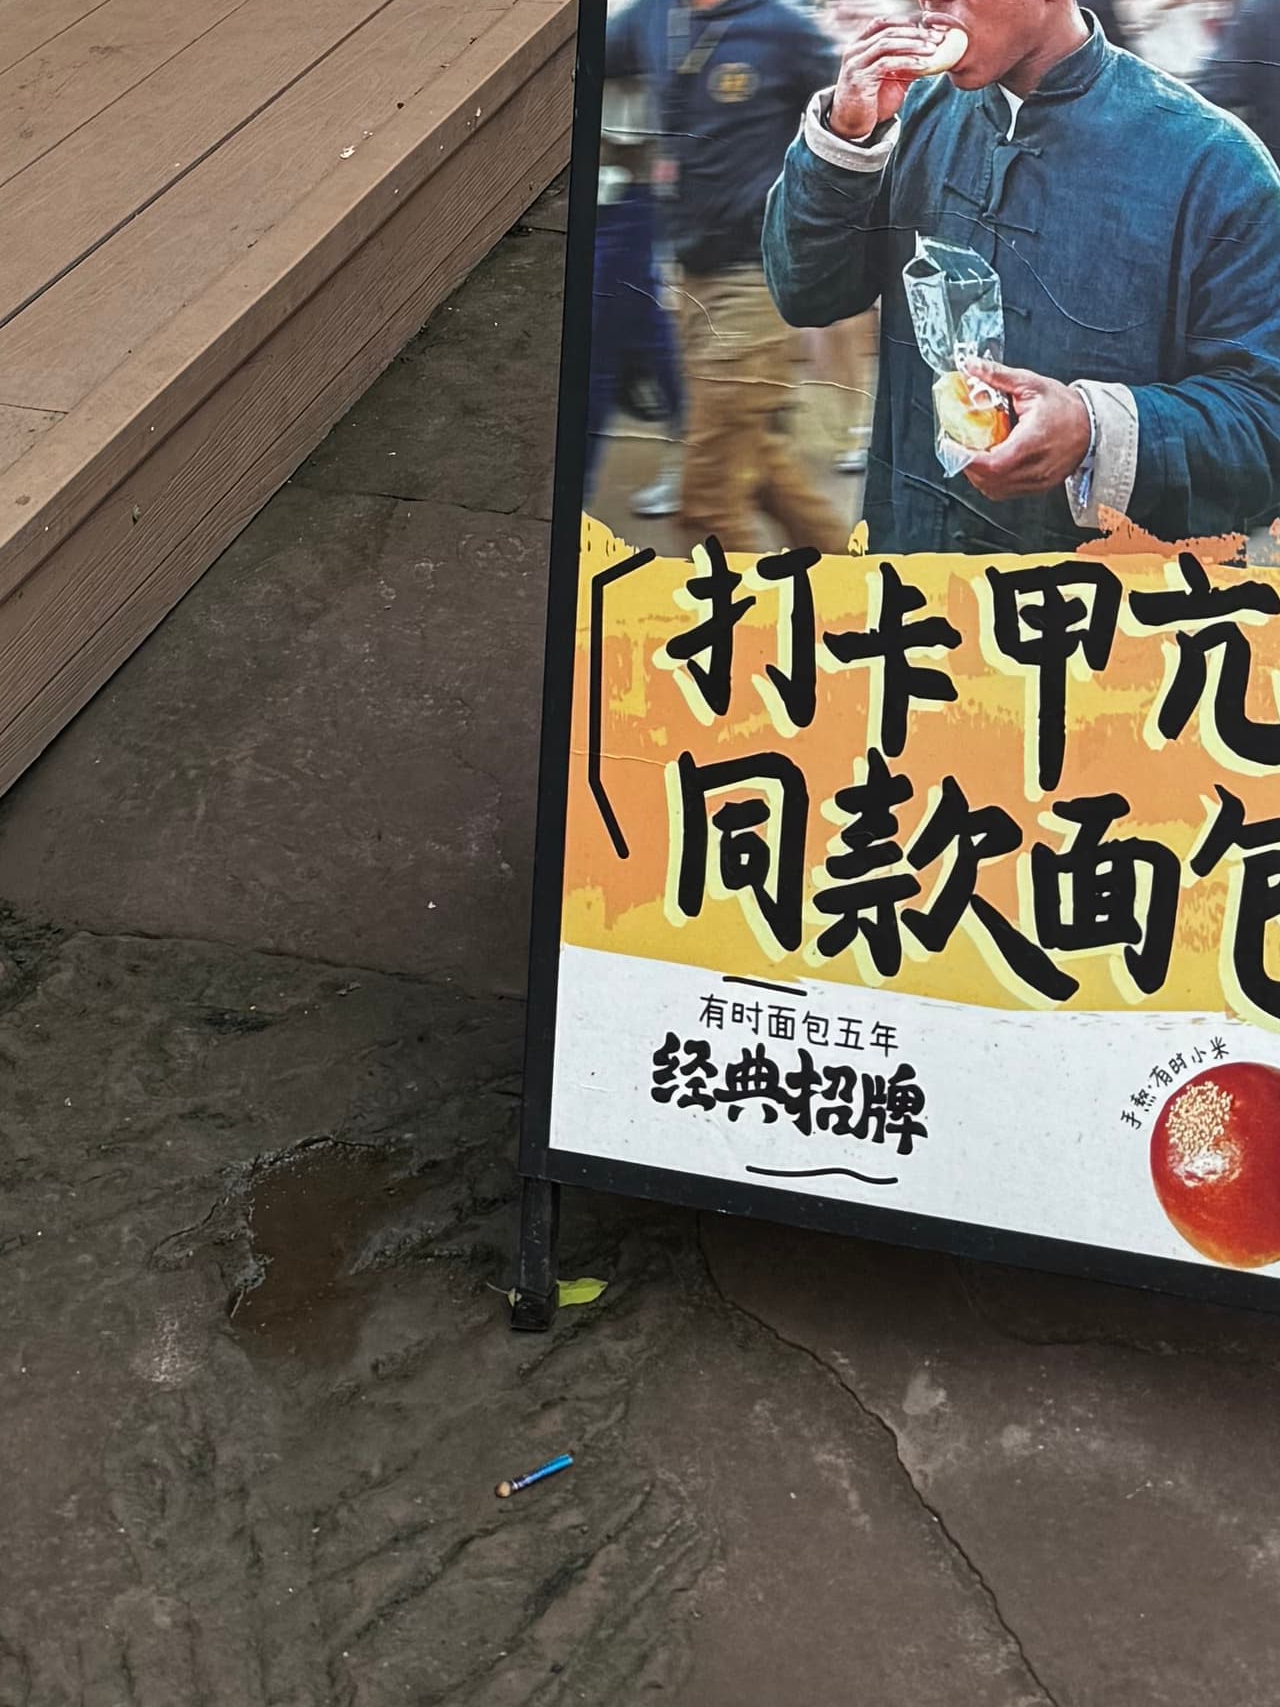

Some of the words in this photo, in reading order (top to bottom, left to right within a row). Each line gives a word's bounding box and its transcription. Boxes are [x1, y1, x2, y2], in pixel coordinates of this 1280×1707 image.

[699, 993, 899, 1058] 有时面包五年
[650, 1031, 929, 1156] 经典招牌
